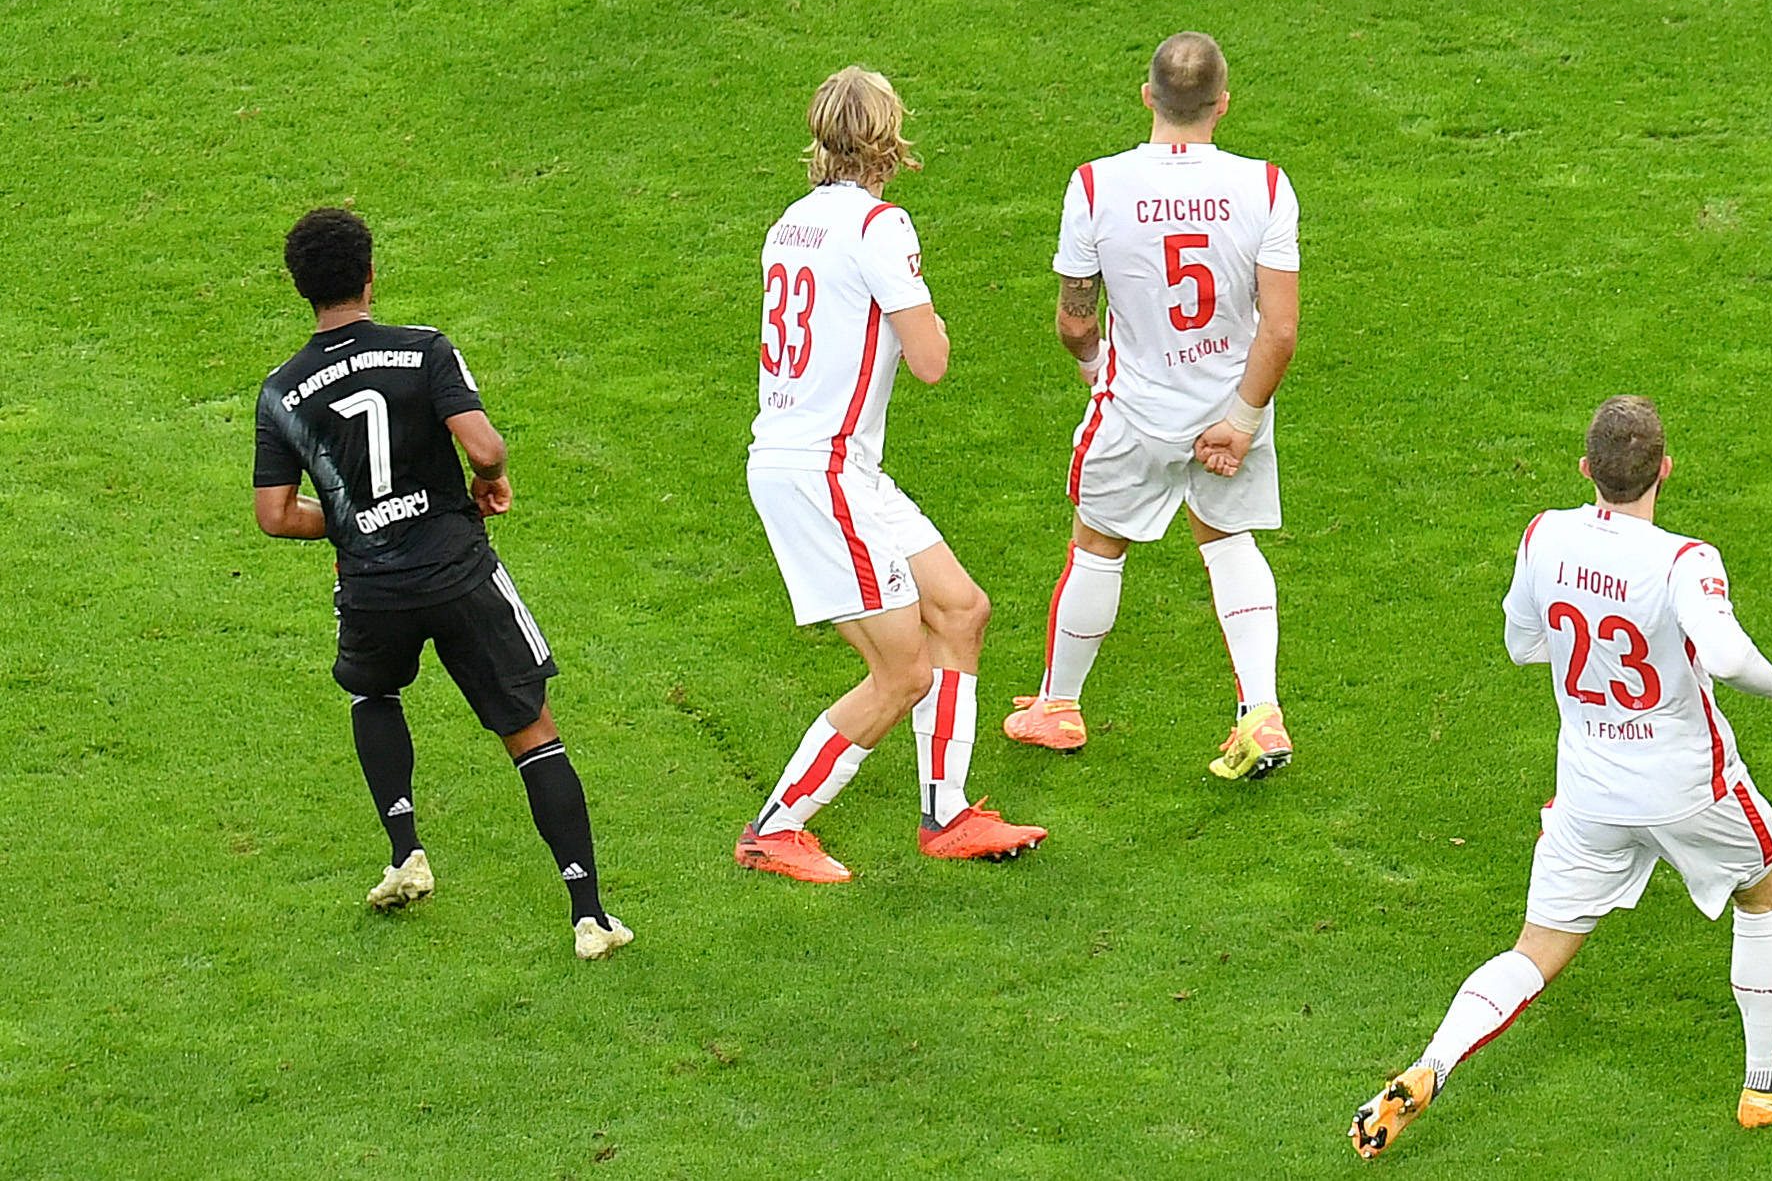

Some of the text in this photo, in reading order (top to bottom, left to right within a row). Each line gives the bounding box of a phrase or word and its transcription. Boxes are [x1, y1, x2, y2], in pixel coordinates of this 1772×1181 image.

[1136, 198, 1231, 224] CZICHOS
[1163, 233, 1216, 332] 5
[760, 262, 816, 379] 33
[281, 350, 424, 413] FC BAYERN MÜNCHEN
[1165, 351, 1178, 367] 1.
[1179, 345, 1199, 366] FC
[328, 388, 393, 500] 7
[354, 489, 430, 535] GNABRY
[1556, 560, 1628, 603] J. HORN
[1547, 600, 1662, 712] 23
[1585, 720, 1596, 738] 1.
[1599, 722, 1617, 740] FC
